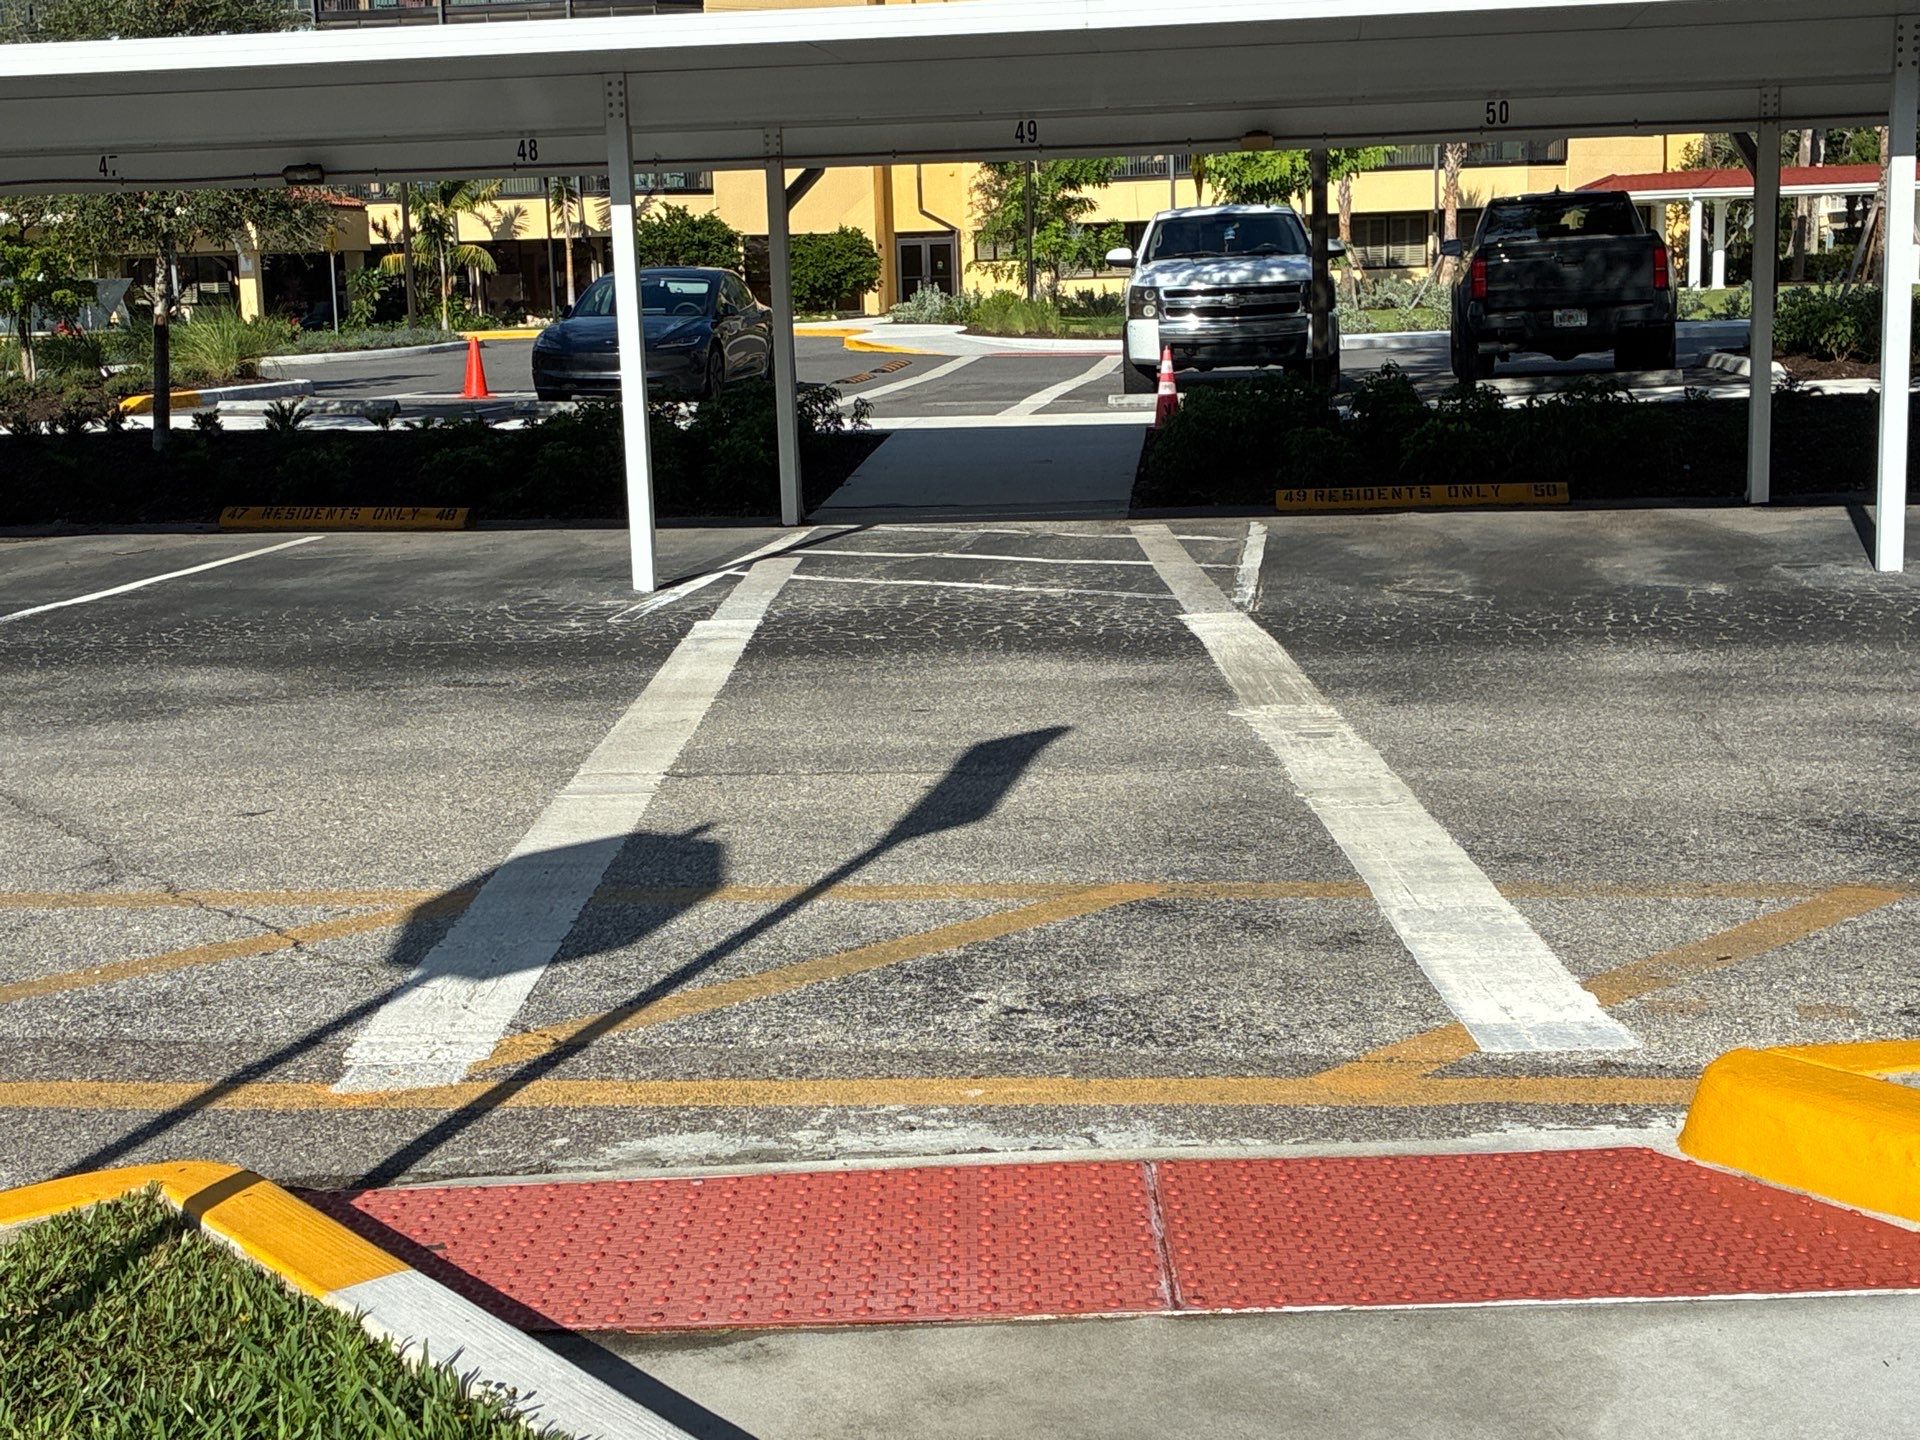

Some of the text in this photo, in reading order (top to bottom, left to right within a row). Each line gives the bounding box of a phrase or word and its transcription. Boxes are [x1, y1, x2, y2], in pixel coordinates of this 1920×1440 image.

[1486, 100, 1509, 125] 50
[1015, 120, 1037, 144] 49
[517, 138, 538, 162] 48
[1283, 483, 1558, 503] 49 RESIDENTS ONLY 50
[226, 507, 250, 520] 47
[261, 506, 361, 520] RESIDENTS
[372, 507, 420, 521] ONLY
